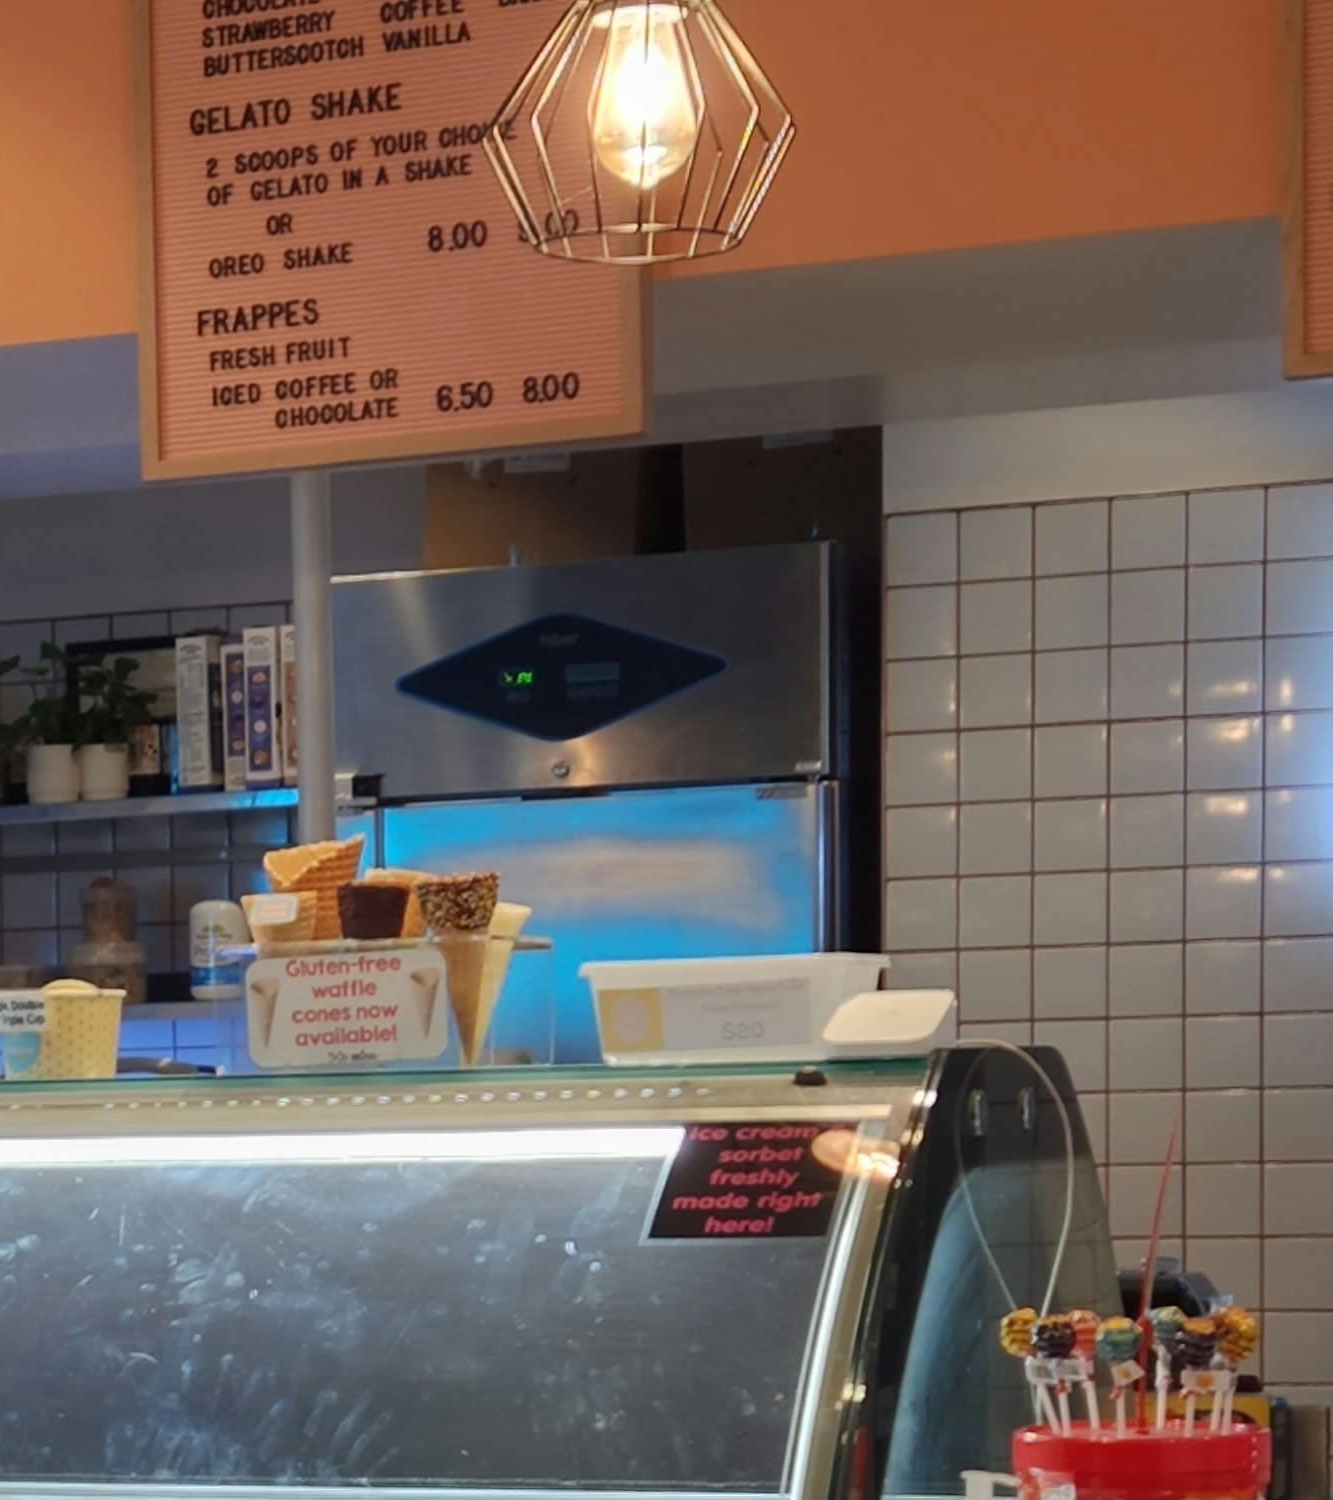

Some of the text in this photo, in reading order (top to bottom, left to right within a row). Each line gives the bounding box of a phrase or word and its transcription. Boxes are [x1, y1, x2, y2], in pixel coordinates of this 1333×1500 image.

[379, 0, 464, 24] COFFEE
[202, 11, 335, 48] STRAWBERRY
[203, 21, 471, 77] BUTTERSCOTCH VANILLA
[189, 82, 403, 138] GELATO SHAKE
[205, 130, 429, 179] 2 SCOOPS OF YOUR
[206, 154, 472, 207] OF GELATO IN A SHAKE
[266, 213, 294, 237] OR
[208, 220, 488, 279] OREO SHAKE 8.00
[196, 299, 320, 337] FRAPPES
[209, 336, 352, 373] FRESH FRUIT
[211, 368, 580, 413] ICED COFFEE OR 6.50 8.00
[274, 397, 401, 430] CHOCOLATE
[285, 954, 401, 978] Gluten-free
[312, 980, 377, 1000] waffle
[292, 1004, 398, 1023] cones now
[295, 1025, 397, 1047] available!
[719, 1147, 804, 1164] sorbet
[710, 1169, 799, 1188] freshly
[672, 1192, 823, 1213] made right
[704, 1217, 774, 1234] here!
